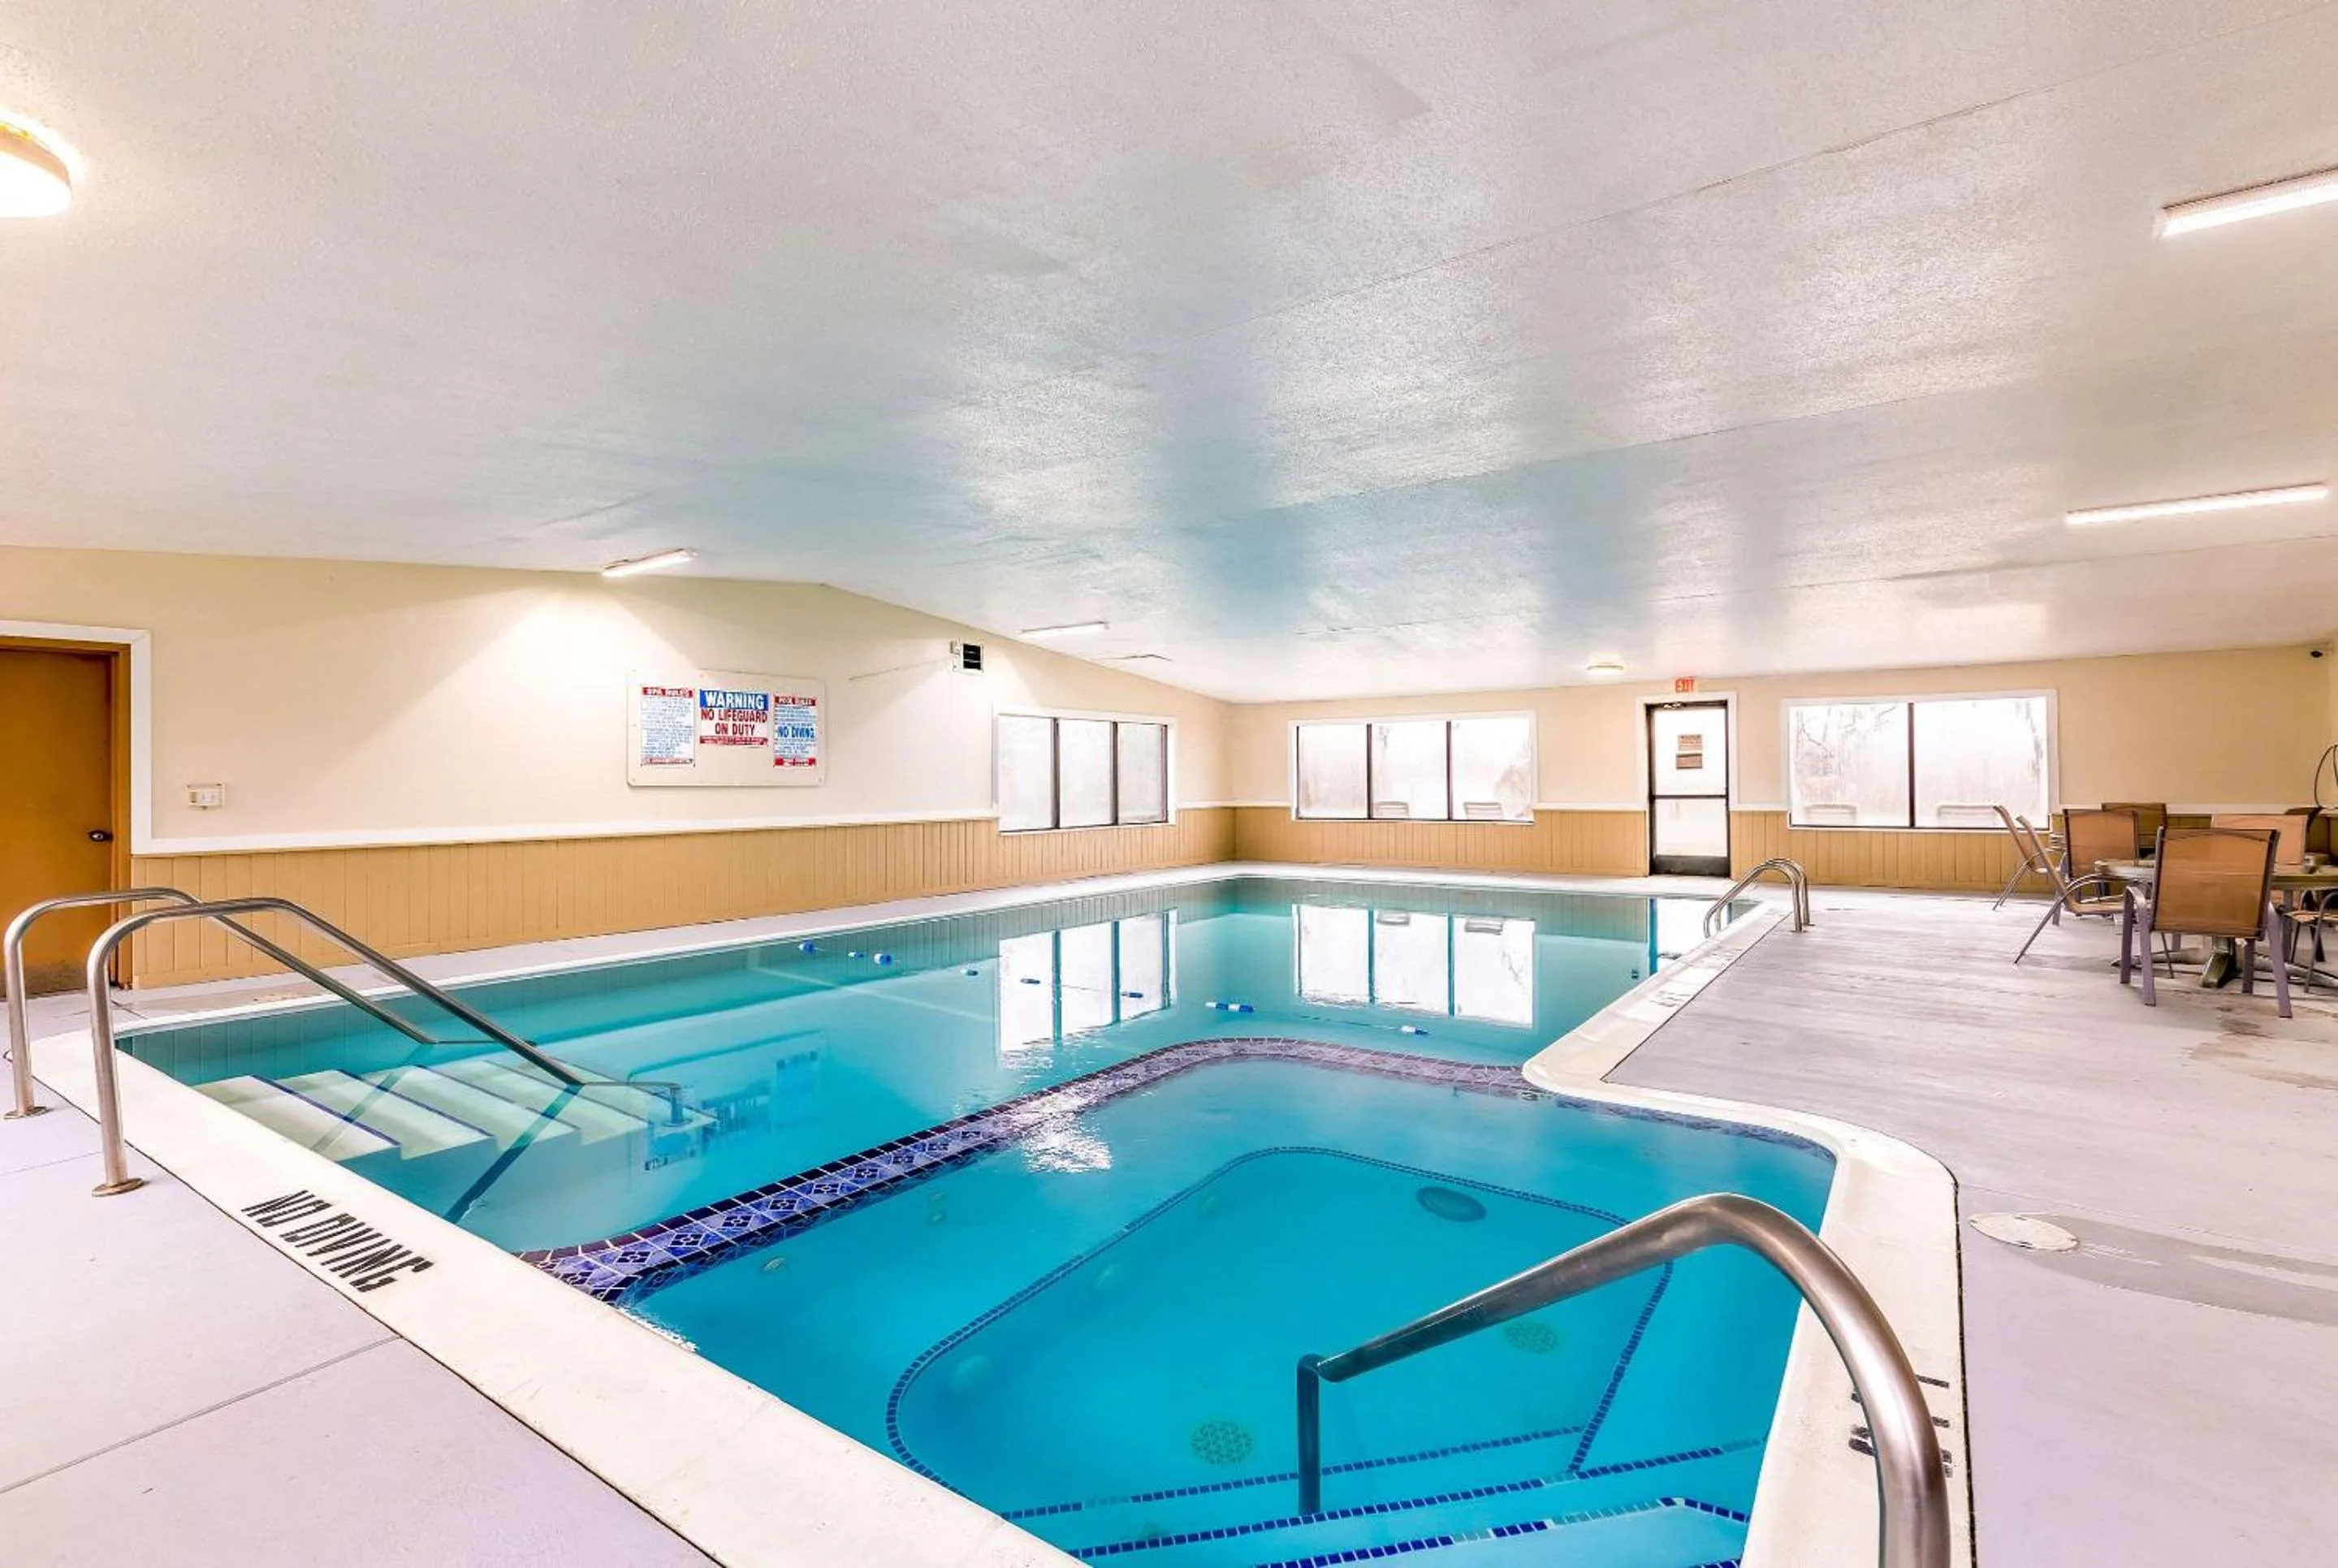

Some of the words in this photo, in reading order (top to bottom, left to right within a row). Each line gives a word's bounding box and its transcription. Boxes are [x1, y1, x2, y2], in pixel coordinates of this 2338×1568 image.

[1675, 678, 1695, 693] EXIT
[704, 691, 765, 709] WARNING
[701, 708, 715, 721] NO
[718, 709, 767, 724] LIFEGUARD
[715, 722, 728, 735] ON
[732, 723, 755, 736] DUTY
[777, 725, 789, 738] NO
[791, 726, 815, 738] DIVING
[240, 1190, 333, 1228] NO
[279, 1213, 434, 1293] DIVING
